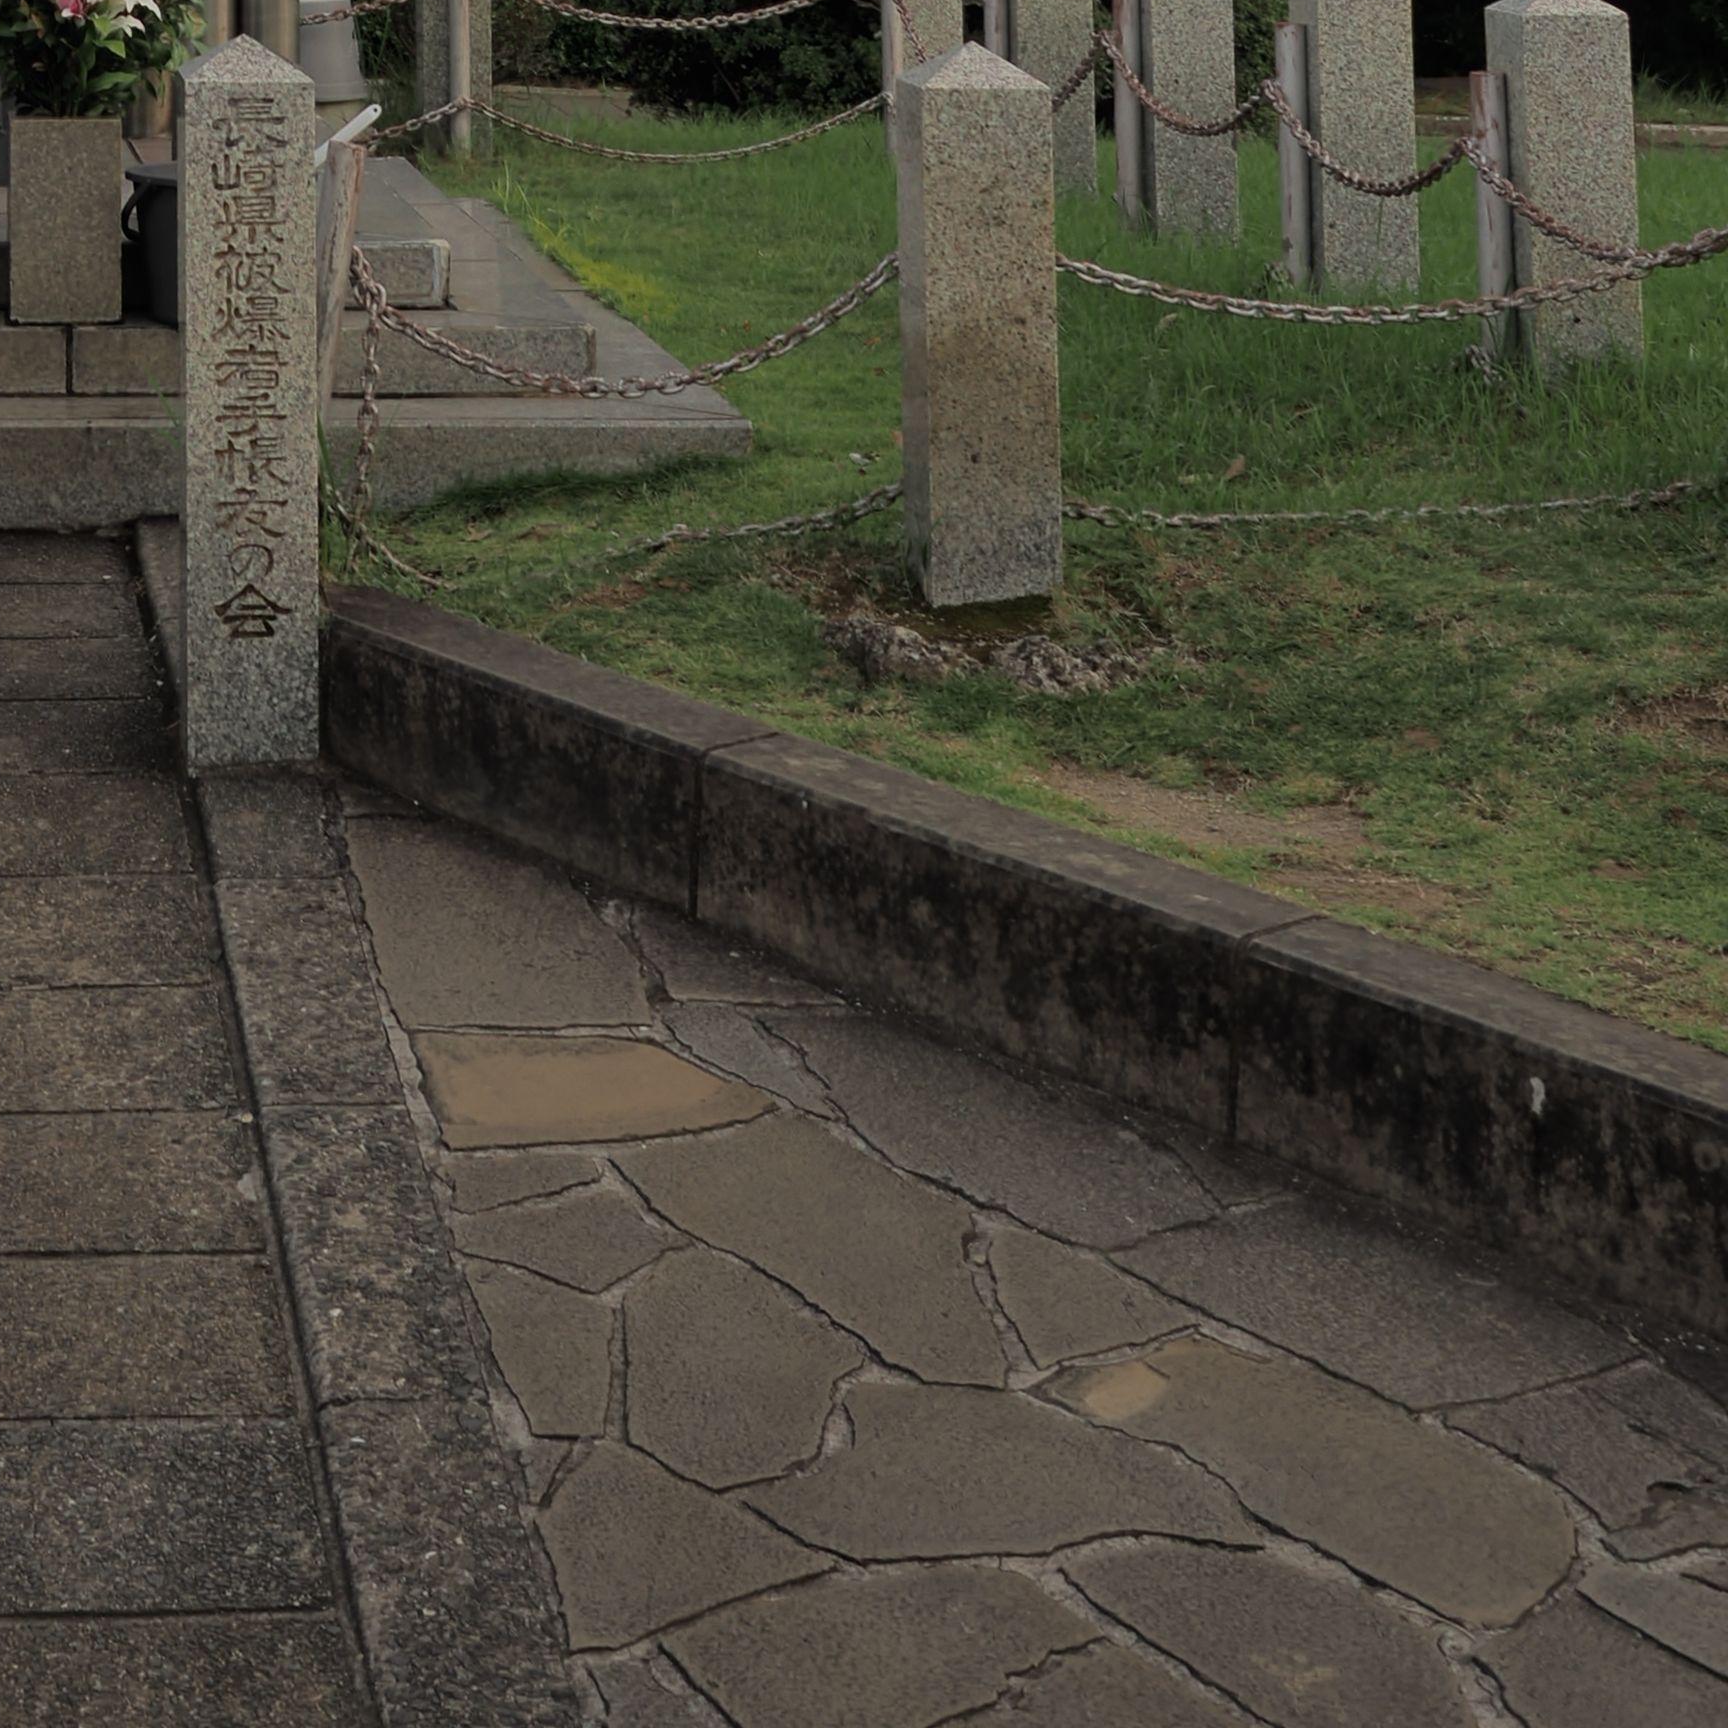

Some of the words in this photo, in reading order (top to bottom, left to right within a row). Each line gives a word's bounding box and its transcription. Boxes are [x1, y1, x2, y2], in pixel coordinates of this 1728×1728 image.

[212, 97, 293, 640] 長崎県被爆者手帳友の会
